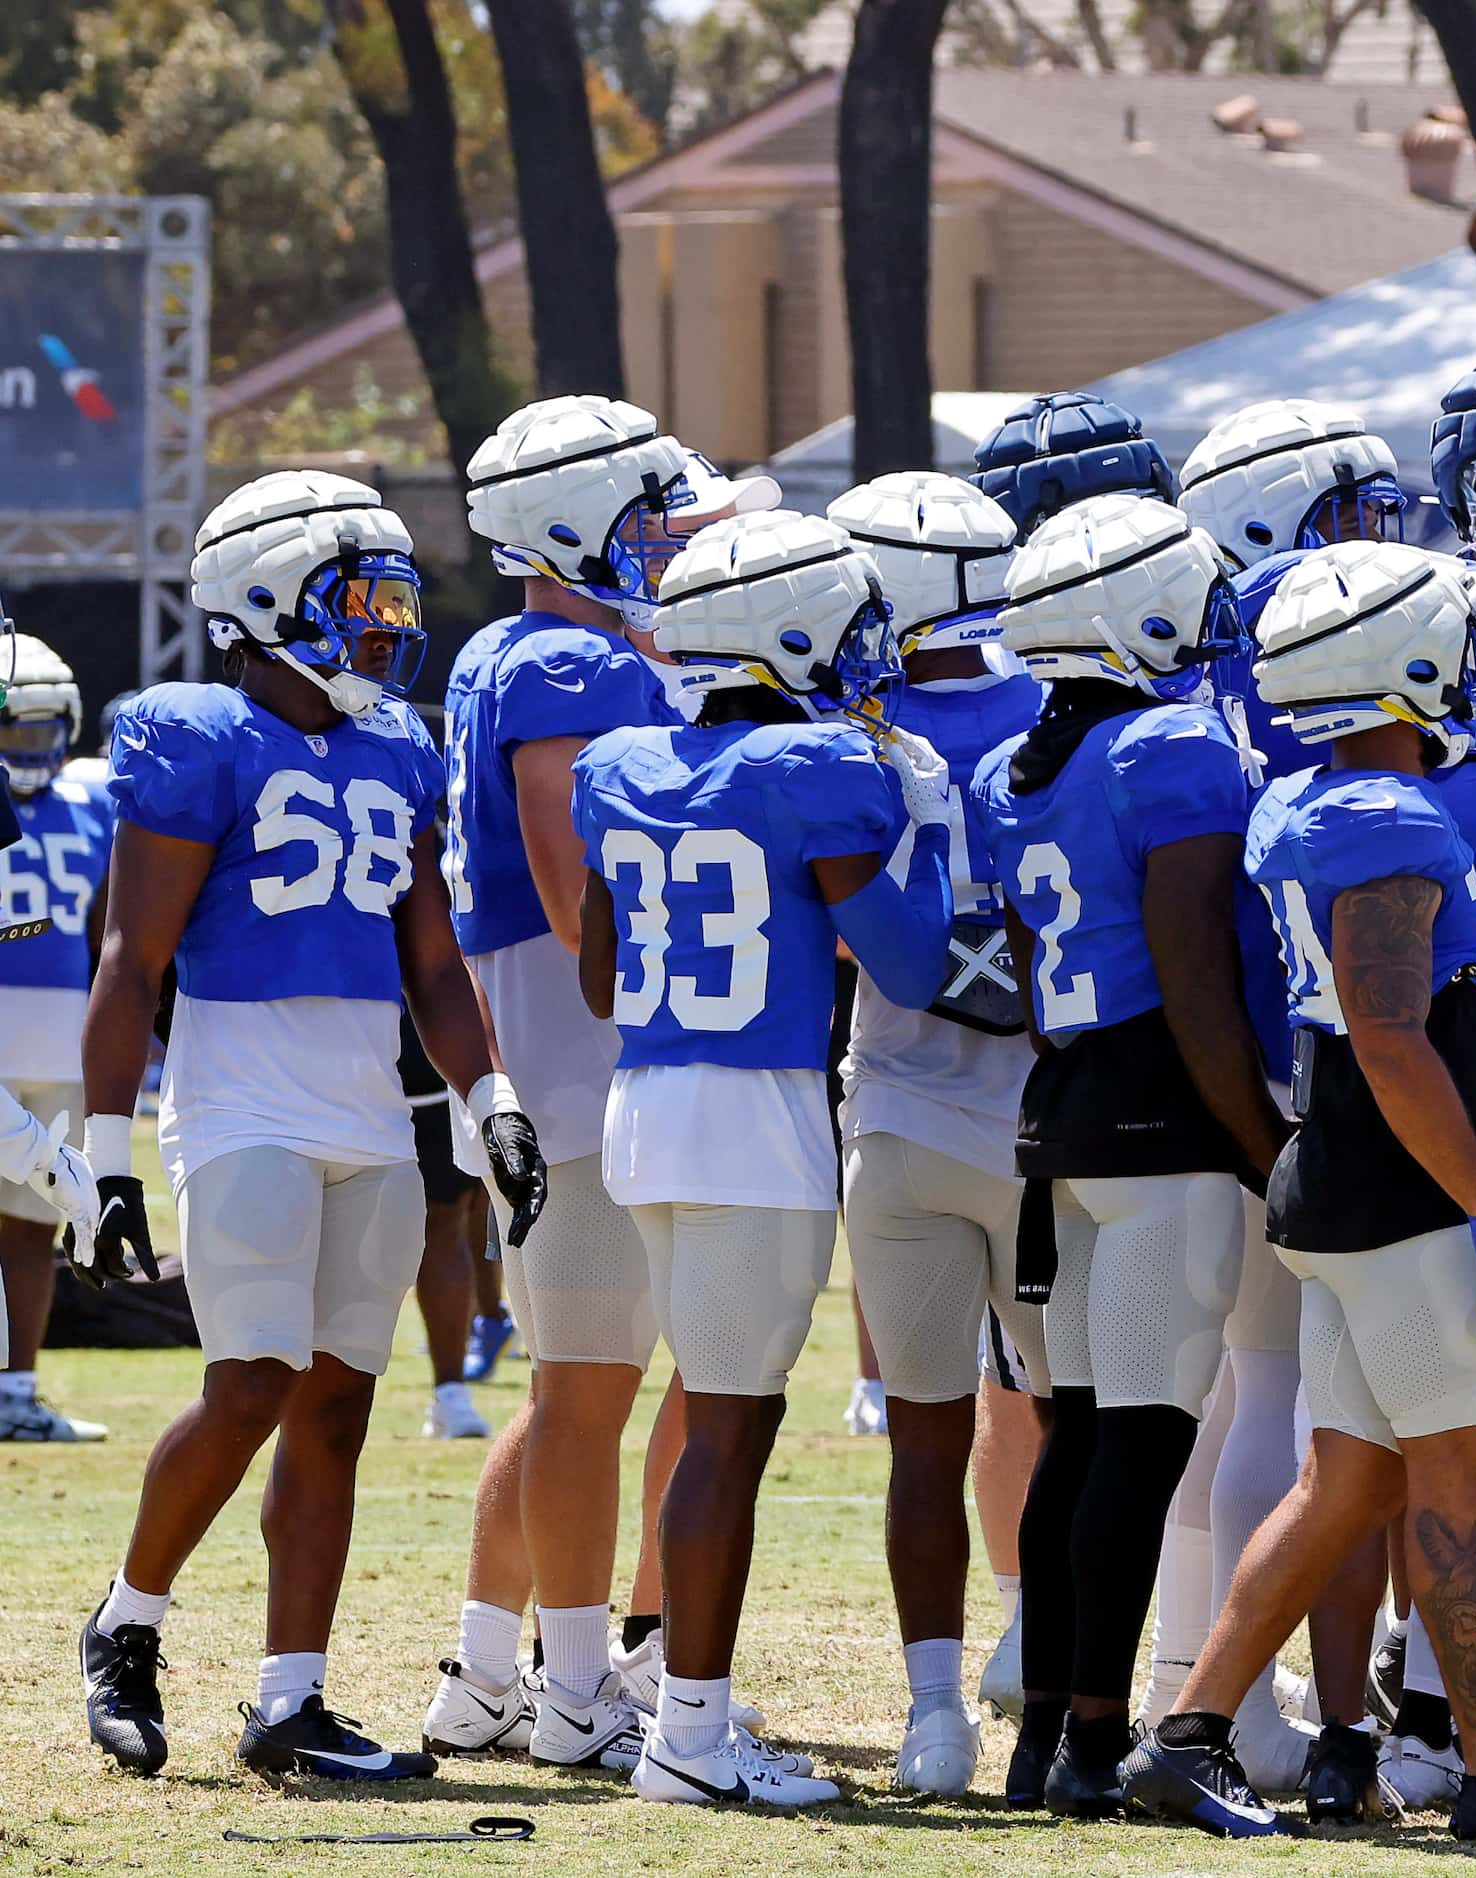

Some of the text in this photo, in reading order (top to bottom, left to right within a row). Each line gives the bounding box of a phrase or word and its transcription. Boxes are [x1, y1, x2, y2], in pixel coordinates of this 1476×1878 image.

[0, 832, 93, 936] 65
[601, 828, 770, 1032] 33
[1017, 841, 1098, 1032] 2
